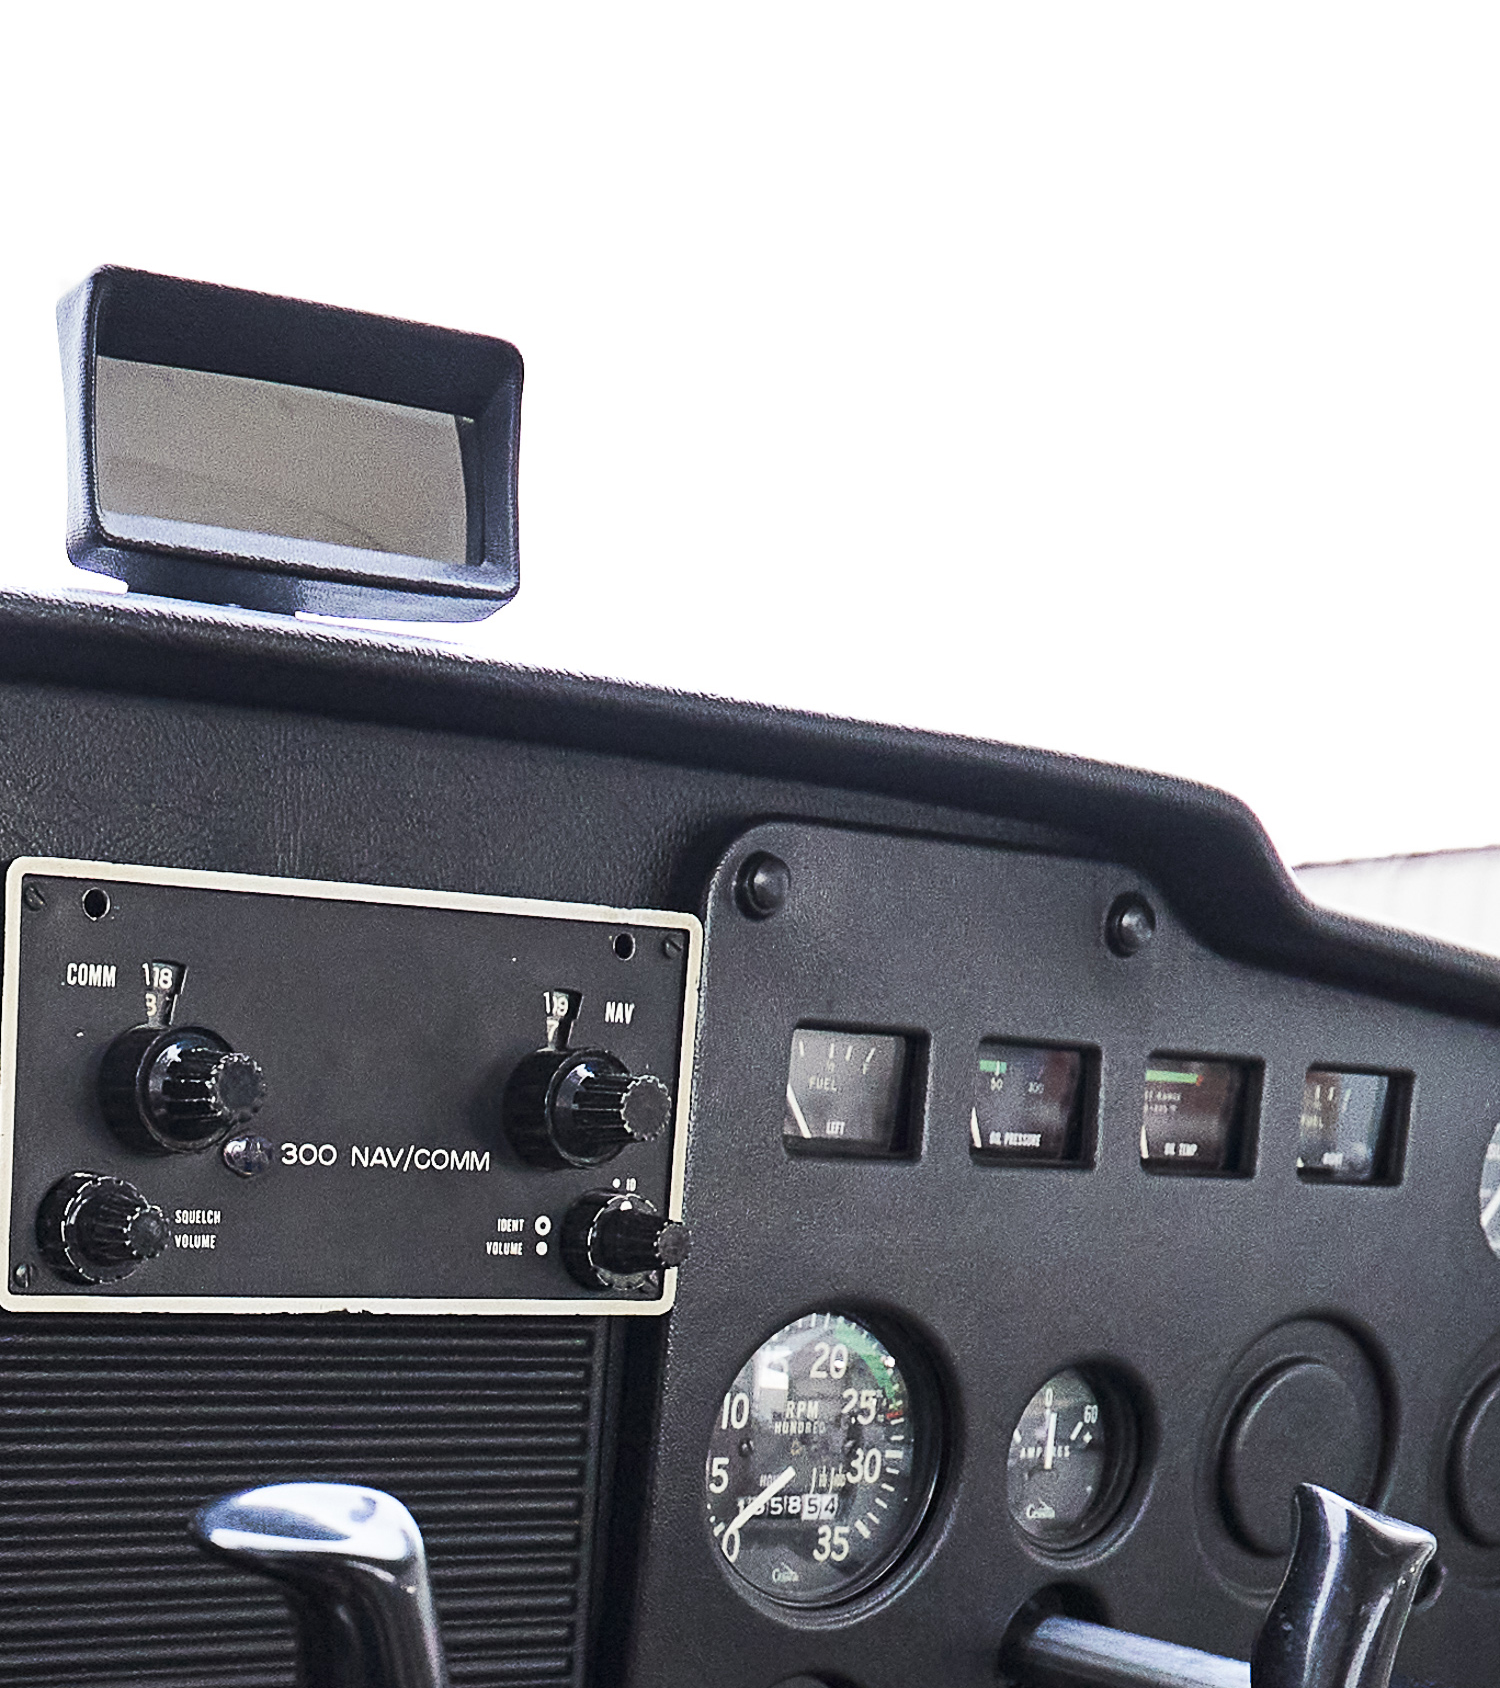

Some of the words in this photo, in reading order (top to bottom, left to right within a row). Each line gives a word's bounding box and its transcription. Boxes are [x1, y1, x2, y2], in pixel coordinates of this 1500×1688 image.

[67, 963, 117, 988] COMM
[605, 1001, 635, 1025] NAV
[809, 1076, 837, 1092] FUEL
[826, 1121, 846, 1136] LEFT
[281, 1142, 338, 1166] 300
[351, 1144, 491, 1172] NAV/COMM
[174, 1210, 221, 1225] SQUELCH
[497, 1218, 525, 1233] IDENT
[174, 1234, 217, 1249] VOLUME
[486, 1241, 523, 1256] VOLUME
[810, 1342, 848, 1379] 20
[1045, 1388, 1053, 1407] 0
[721, 1392, 749, 1430] 10
[786, 1401, 819, 1419] RPM
[1084, 1405, 1098, 1423] 60
[775, 1421, 826, 1435] HUNDRED
[1020, 1446, 1070, 1459] AMPES
[709, 1457, 729, 1493] 5
[846, 1448, 881, 1484] 30
[722, 1528, 740, 1563] 0
[813, 1525, 850, 1562] 35
